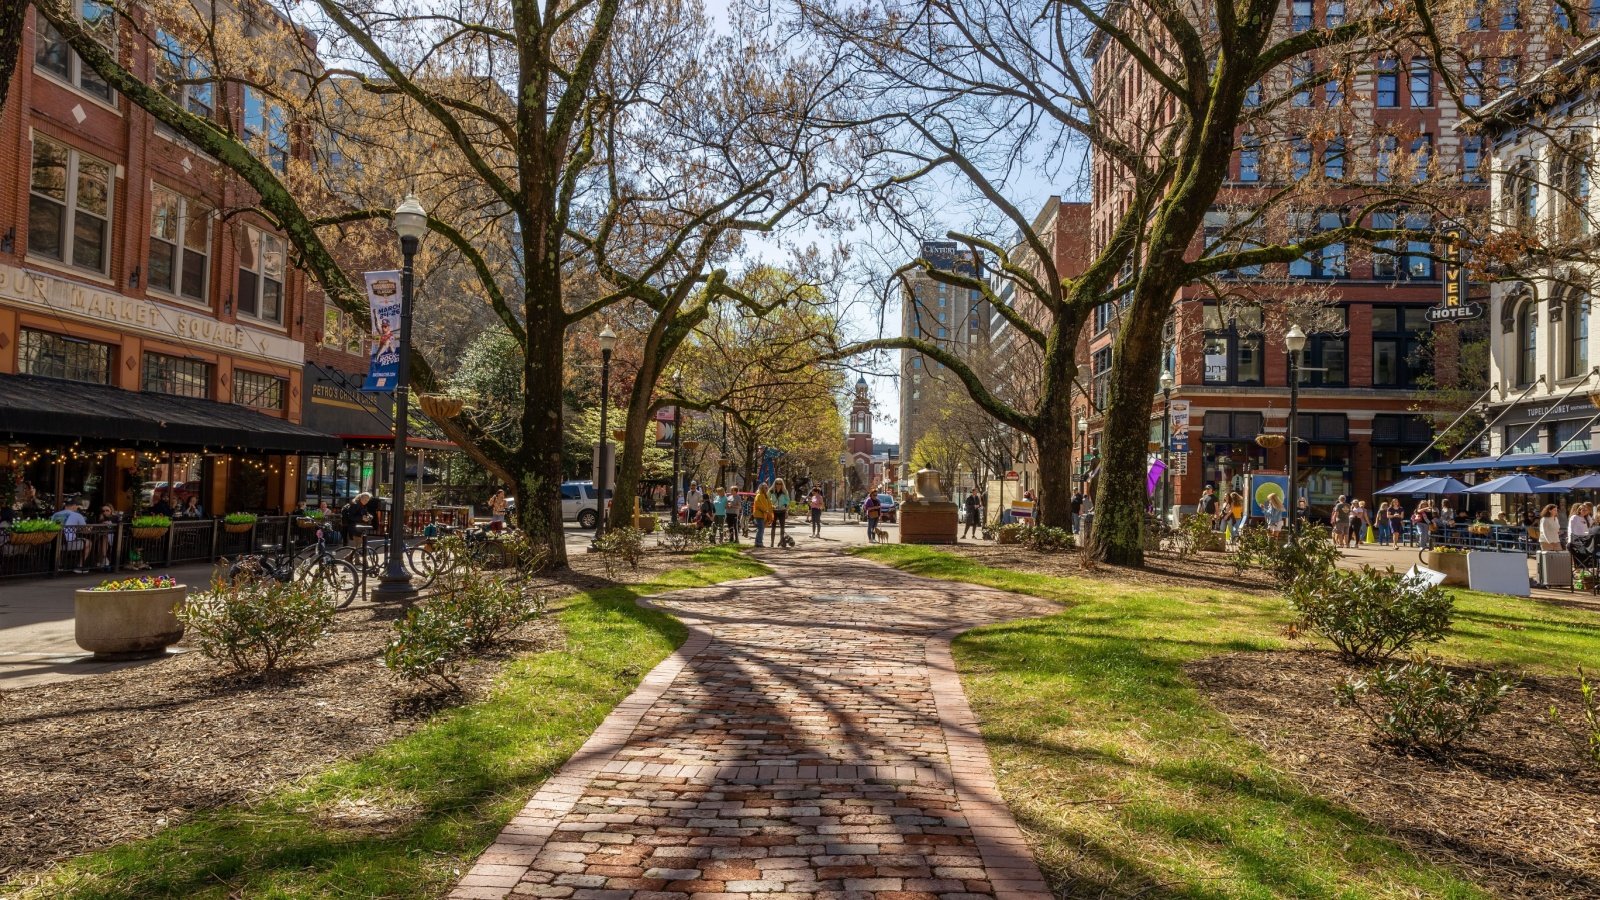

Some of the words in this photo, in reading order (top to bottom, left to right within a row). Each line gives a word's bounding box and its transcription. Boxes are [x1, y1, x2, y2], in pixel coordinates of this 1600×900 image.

[71, 285, 160, 327] MARKET
[177, 314, 245, 348] SQUARE
[1432, 307, 1473, 319] HOTEL
[312, 384, 338, 398] PETRO'S
[1528, 407, 1549, 417] TUPELO
